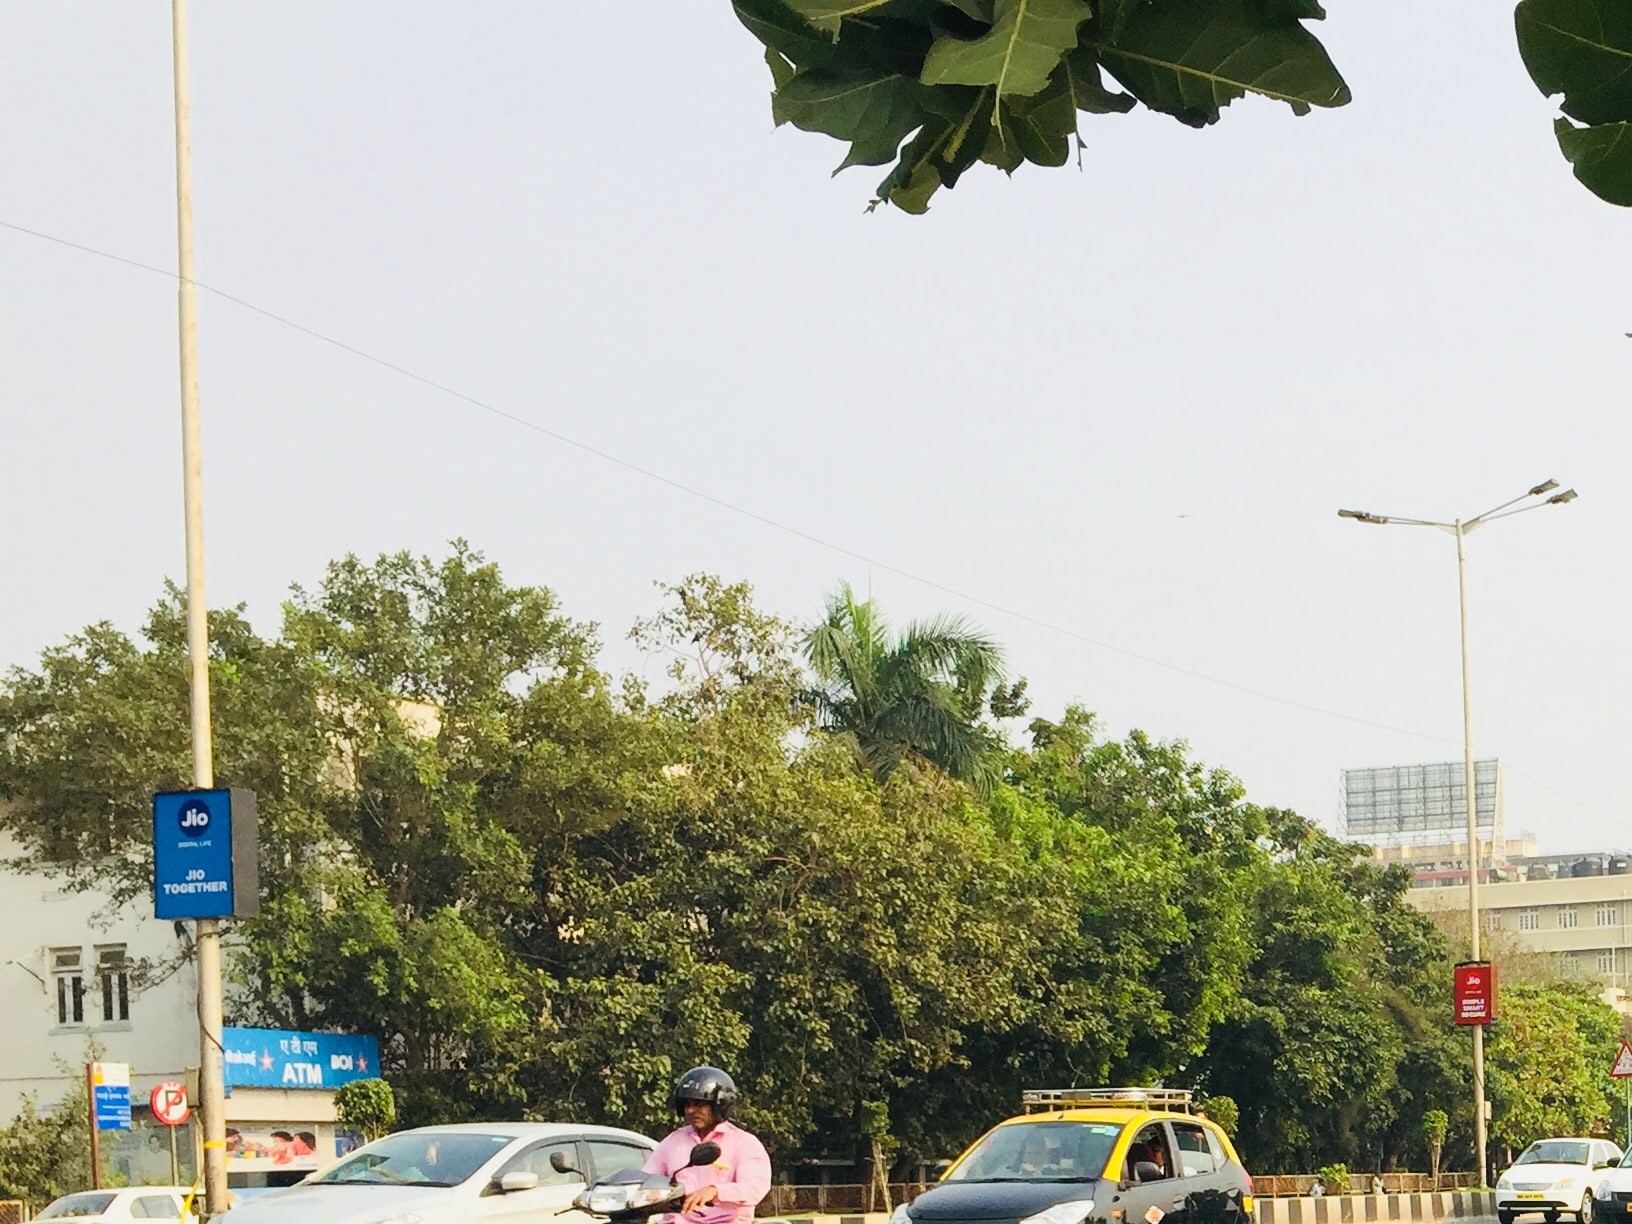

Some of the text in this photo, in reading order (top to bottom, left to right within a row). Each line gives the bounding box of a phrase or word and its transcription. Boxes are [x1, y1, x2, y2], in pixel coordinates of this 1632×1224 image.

[181, 808, 209, 827] Jio
[185, 869, 206, 881] JIO
[163, 881, 228, 895] TOGETHER
[330, 1054, 353, 1071] BOI
[282, 1062, 323, 1085] ATM
